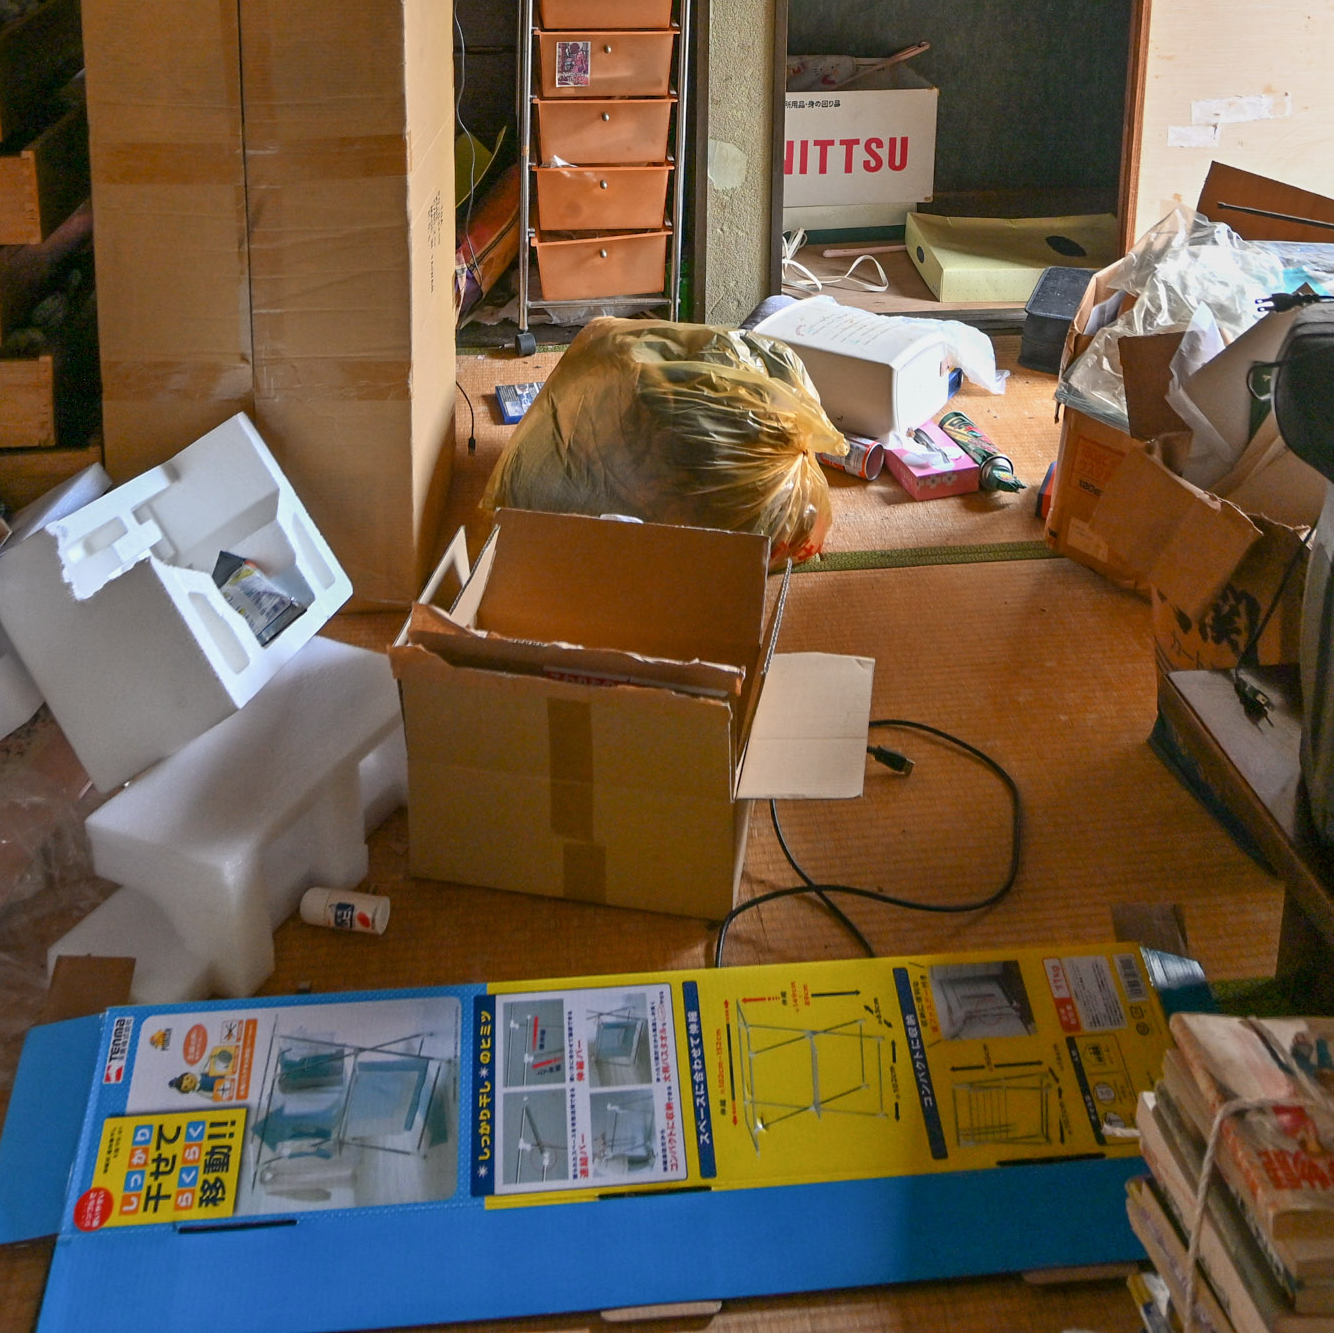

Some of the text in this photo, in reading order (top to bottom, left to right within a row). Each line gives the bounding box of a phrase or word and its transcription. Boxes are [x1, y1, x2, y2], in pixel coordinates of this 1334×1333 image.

[688, 1011, 710, 1144] スペースに合わせて伸縮
[905, 1014, 933, 1107] コンパクトに収納
[122, 1127, 150, 1211] しっかり
[143, 1123, 182, 1213] 干せて
[177, 1124, 203, 1206] らくらく
